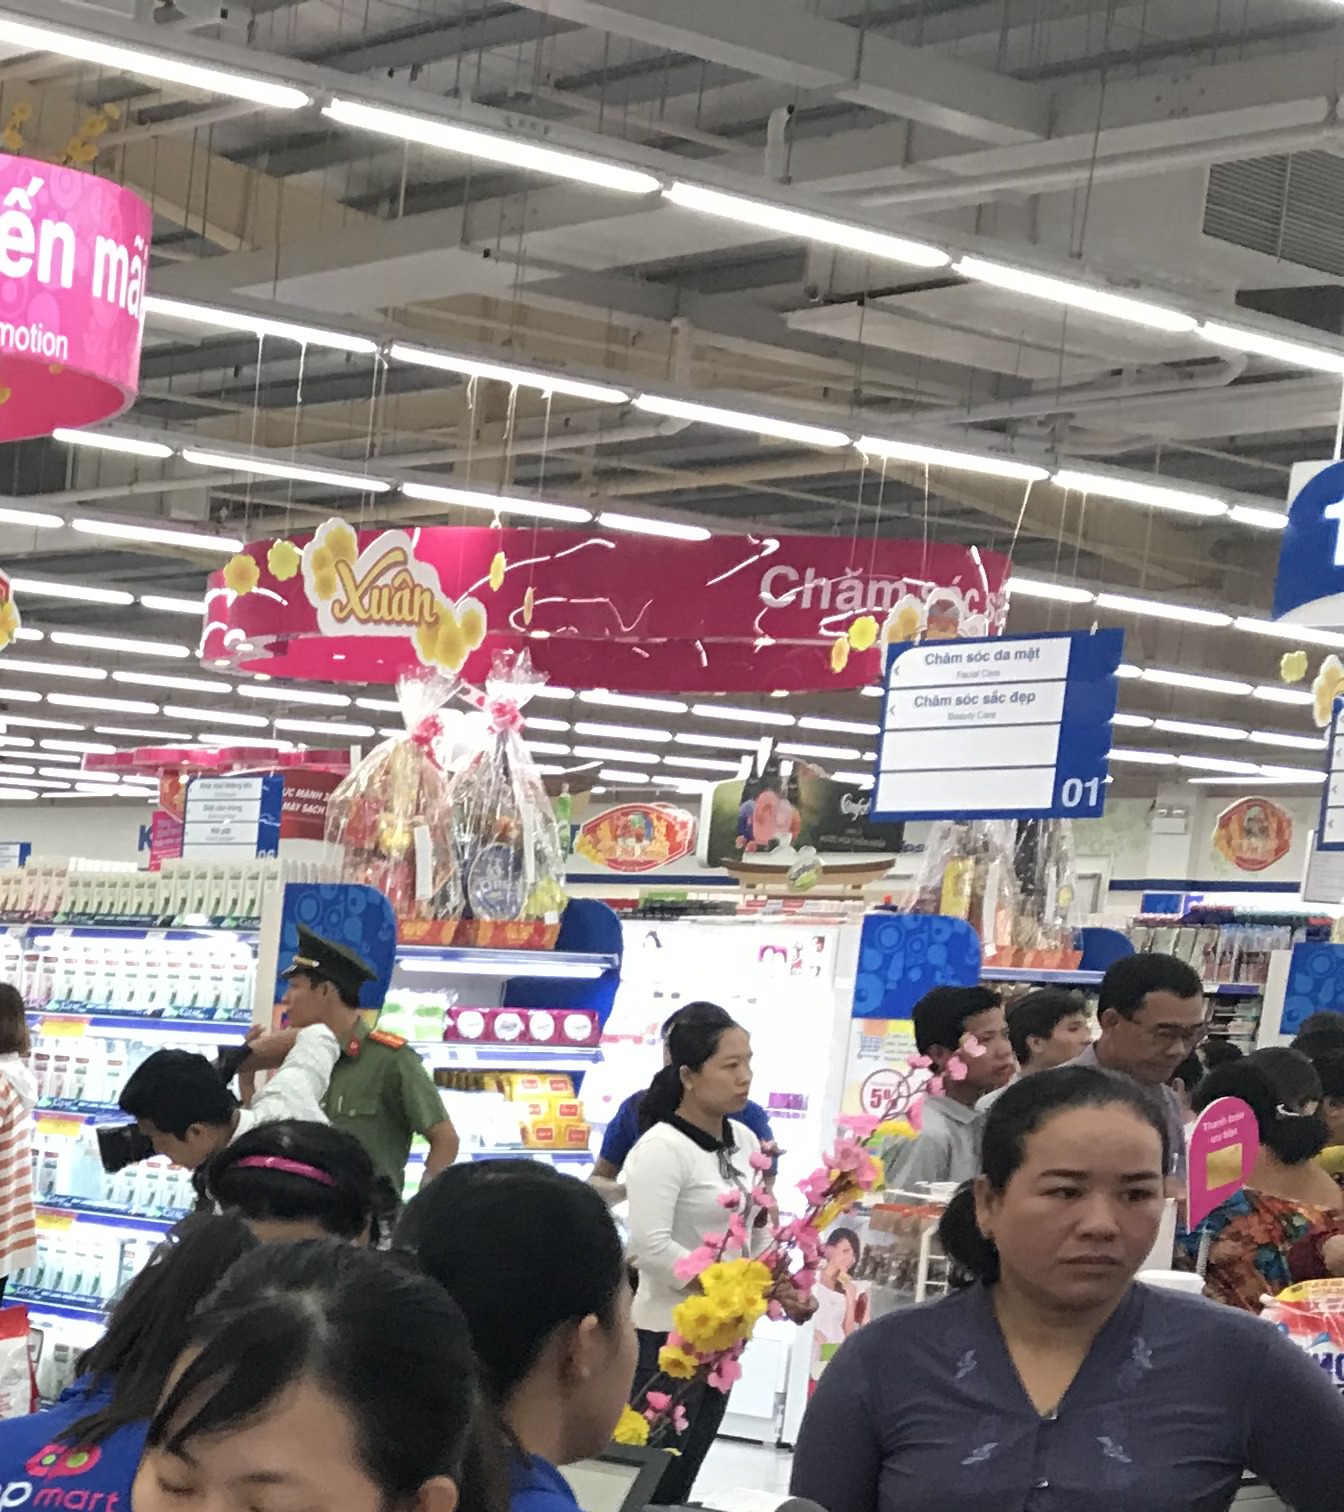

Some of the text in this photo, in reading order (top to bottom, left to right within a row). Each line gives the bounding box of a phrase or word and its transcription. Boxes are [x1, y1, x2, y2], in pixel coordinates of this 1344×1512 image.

[331, 547, 440, 626] Xuân
[759, 562, 906, 611] Chăm
[925, 646, 1041, 666] Chăm sóc da mặt
[914, 689, 1036, 708] Chăm sóc sắc đẹp
[1062, 775, 1100, 808] 01
